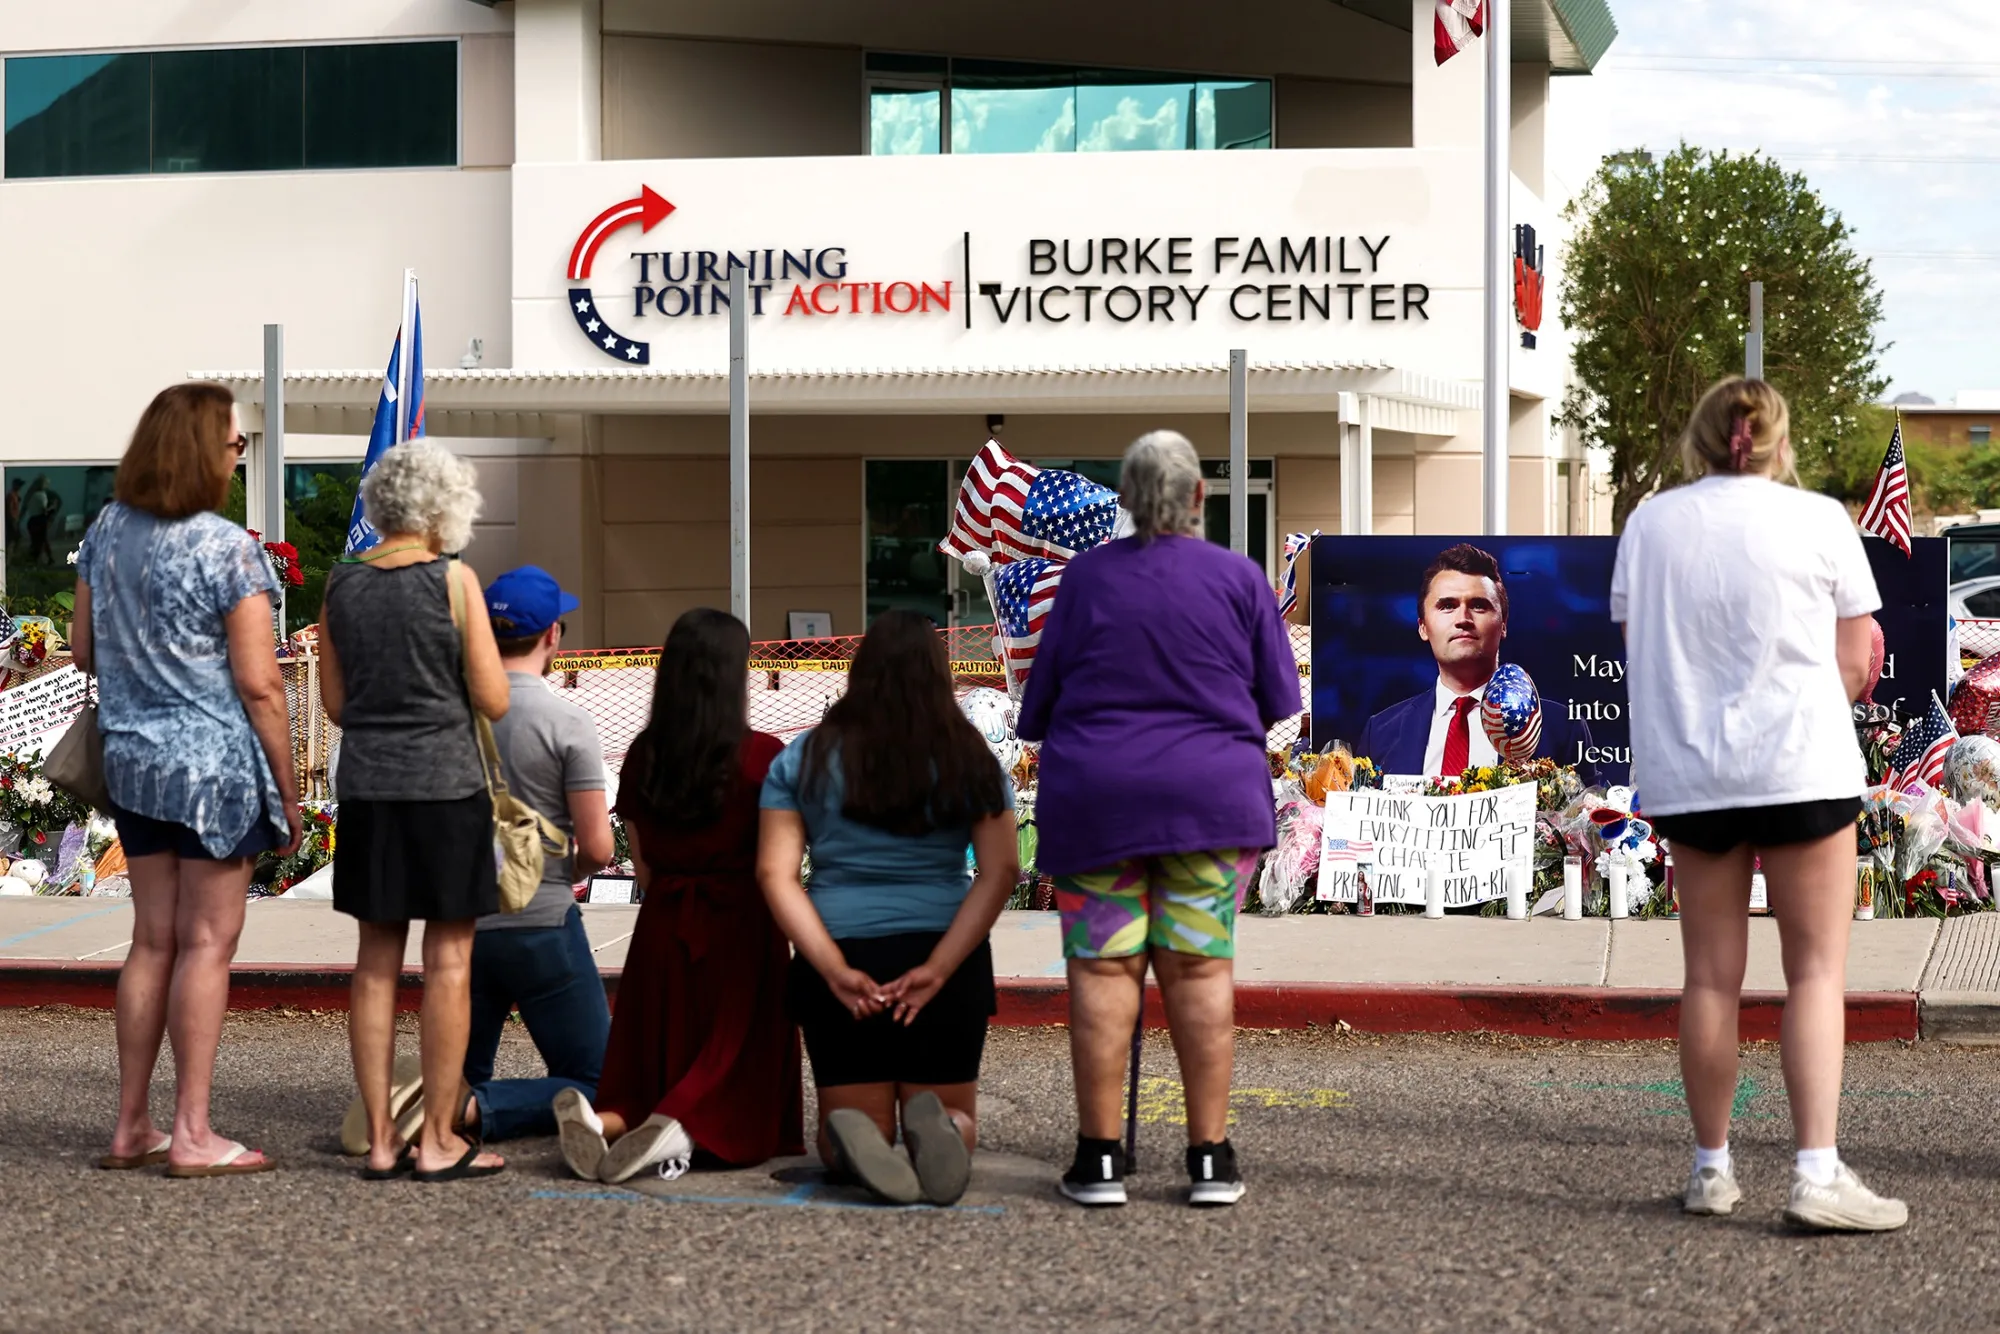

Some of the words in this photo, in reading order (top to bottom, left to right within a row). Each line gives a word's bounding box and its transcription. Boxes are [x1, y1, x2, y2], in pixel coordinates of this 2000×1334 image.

[630, 247, 848, 283] TURNING
[1029, 238, 1193, 275] BURKE
[1215, 236, 1390, 274] FAMILY
[783, 281, 953, 316] ACTION
[989, 285, 1209, 323] VICTORY
[1229, 283, 1429, 321] CENTER
[553, 659, 603, 669] CUIDADO
[625, 657, 660, 667] CAUTI
[821, 661, 850, 670] CAUT
[951, 662, 1001, 672] CAUTION
[1573, 654, 1629, 682] May
[1568, 698, 1620, 720] into
[1572, 741, 1634, 766] Jesu
[1340, 795, 1413, 822] THANK
[1426, 803, 1457, 828] YOU
[1469, 796, 1499, 826] FOR
[1443, 875, 1478, 904] RIKA
